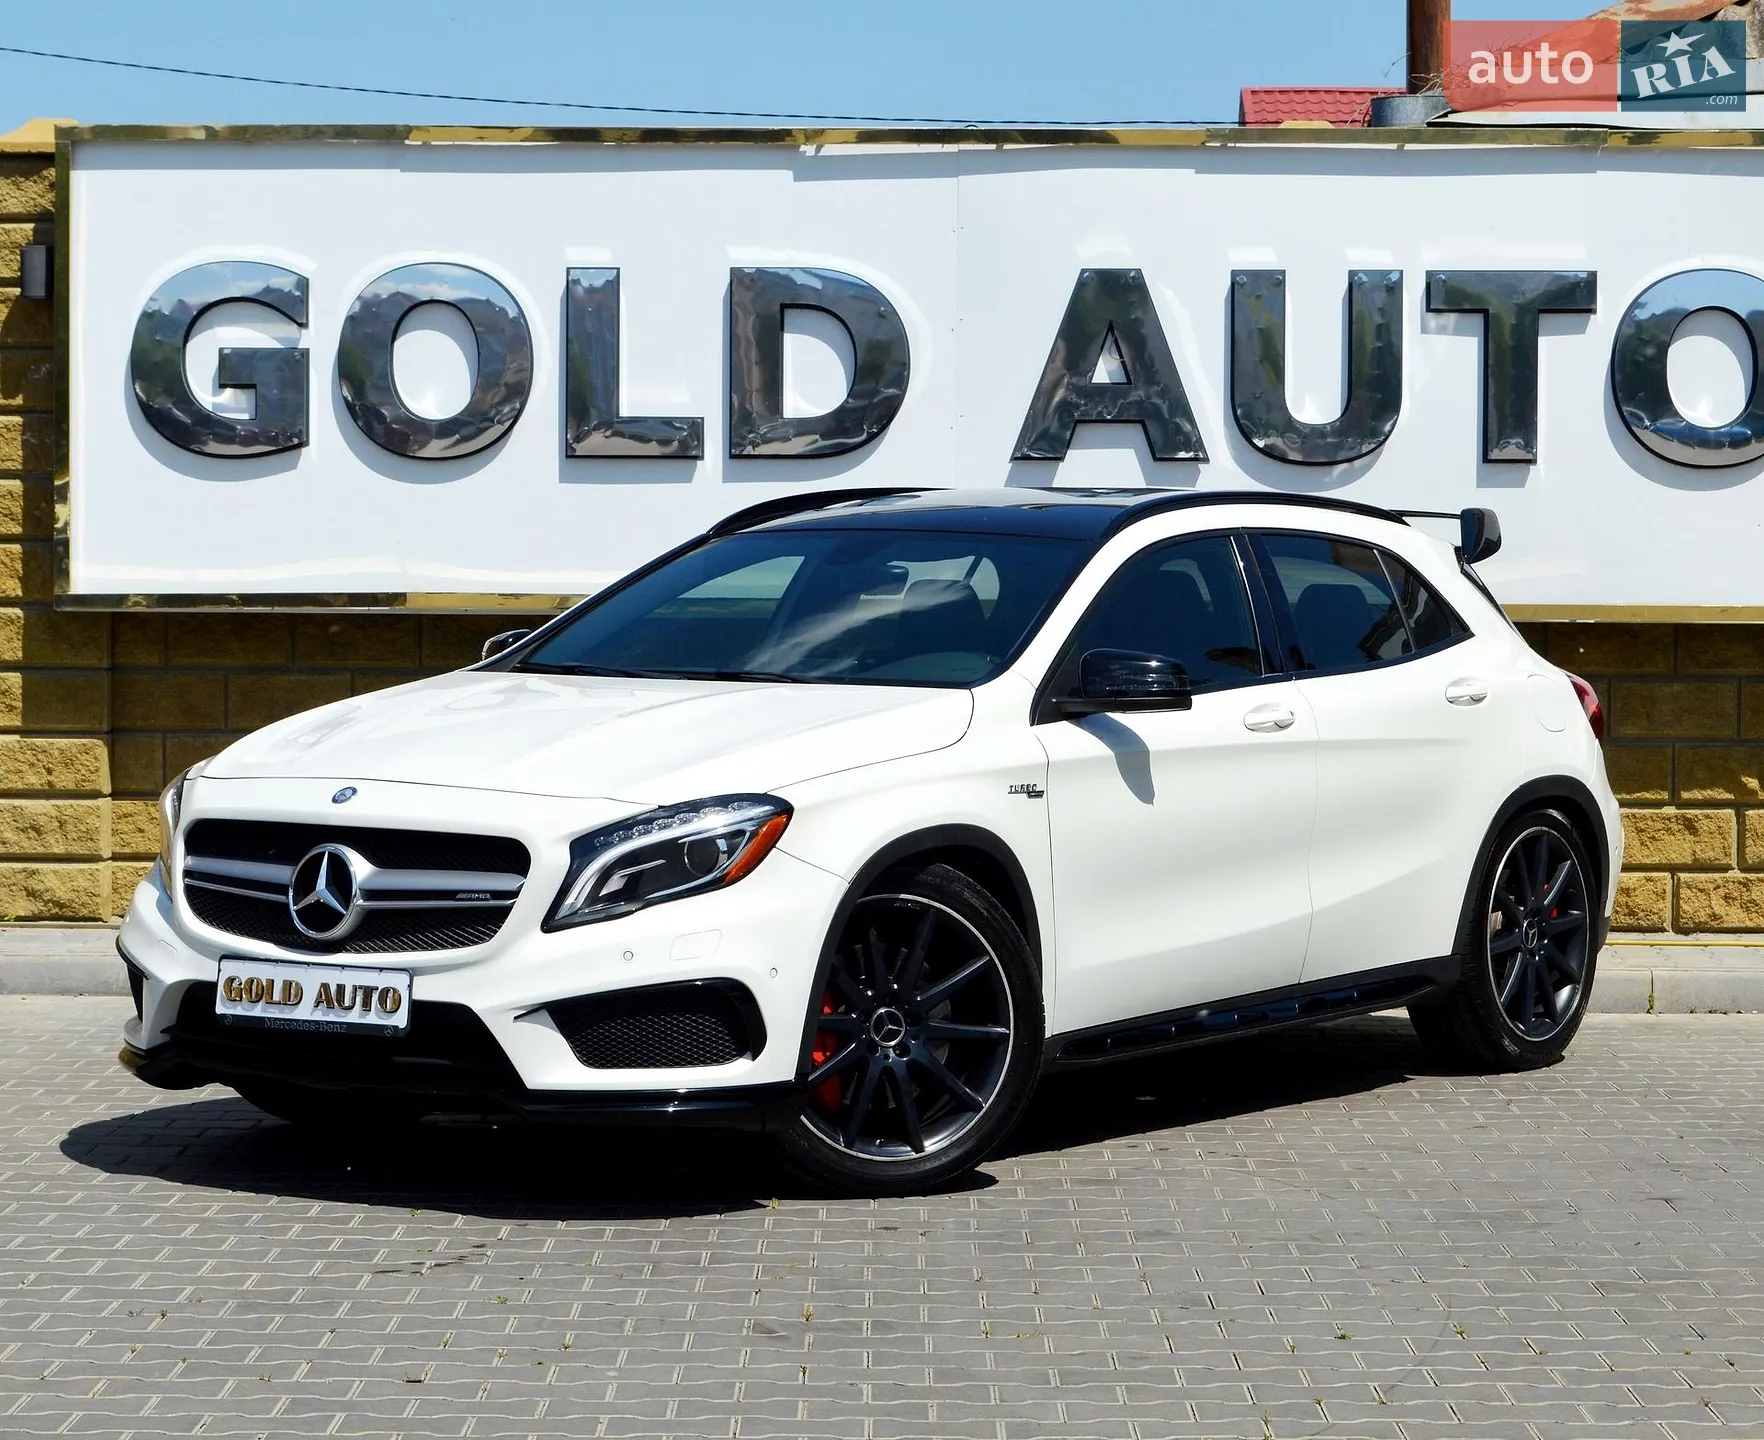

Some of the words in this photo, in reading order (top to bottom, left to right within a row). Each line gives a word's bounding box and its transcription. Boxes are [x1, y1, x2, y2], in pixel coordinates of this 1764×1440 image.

[129, 260, 911, 460] GOLD
[1010, 268, 1764, 470] AUTO
[1008, 784, 1038, 793] TURBO
[222, 975, 304, 1006] GOLD
[313, 982, 402, 1014] AUTO
[264, 1018, 348, 1033] Mercedes-Benz
